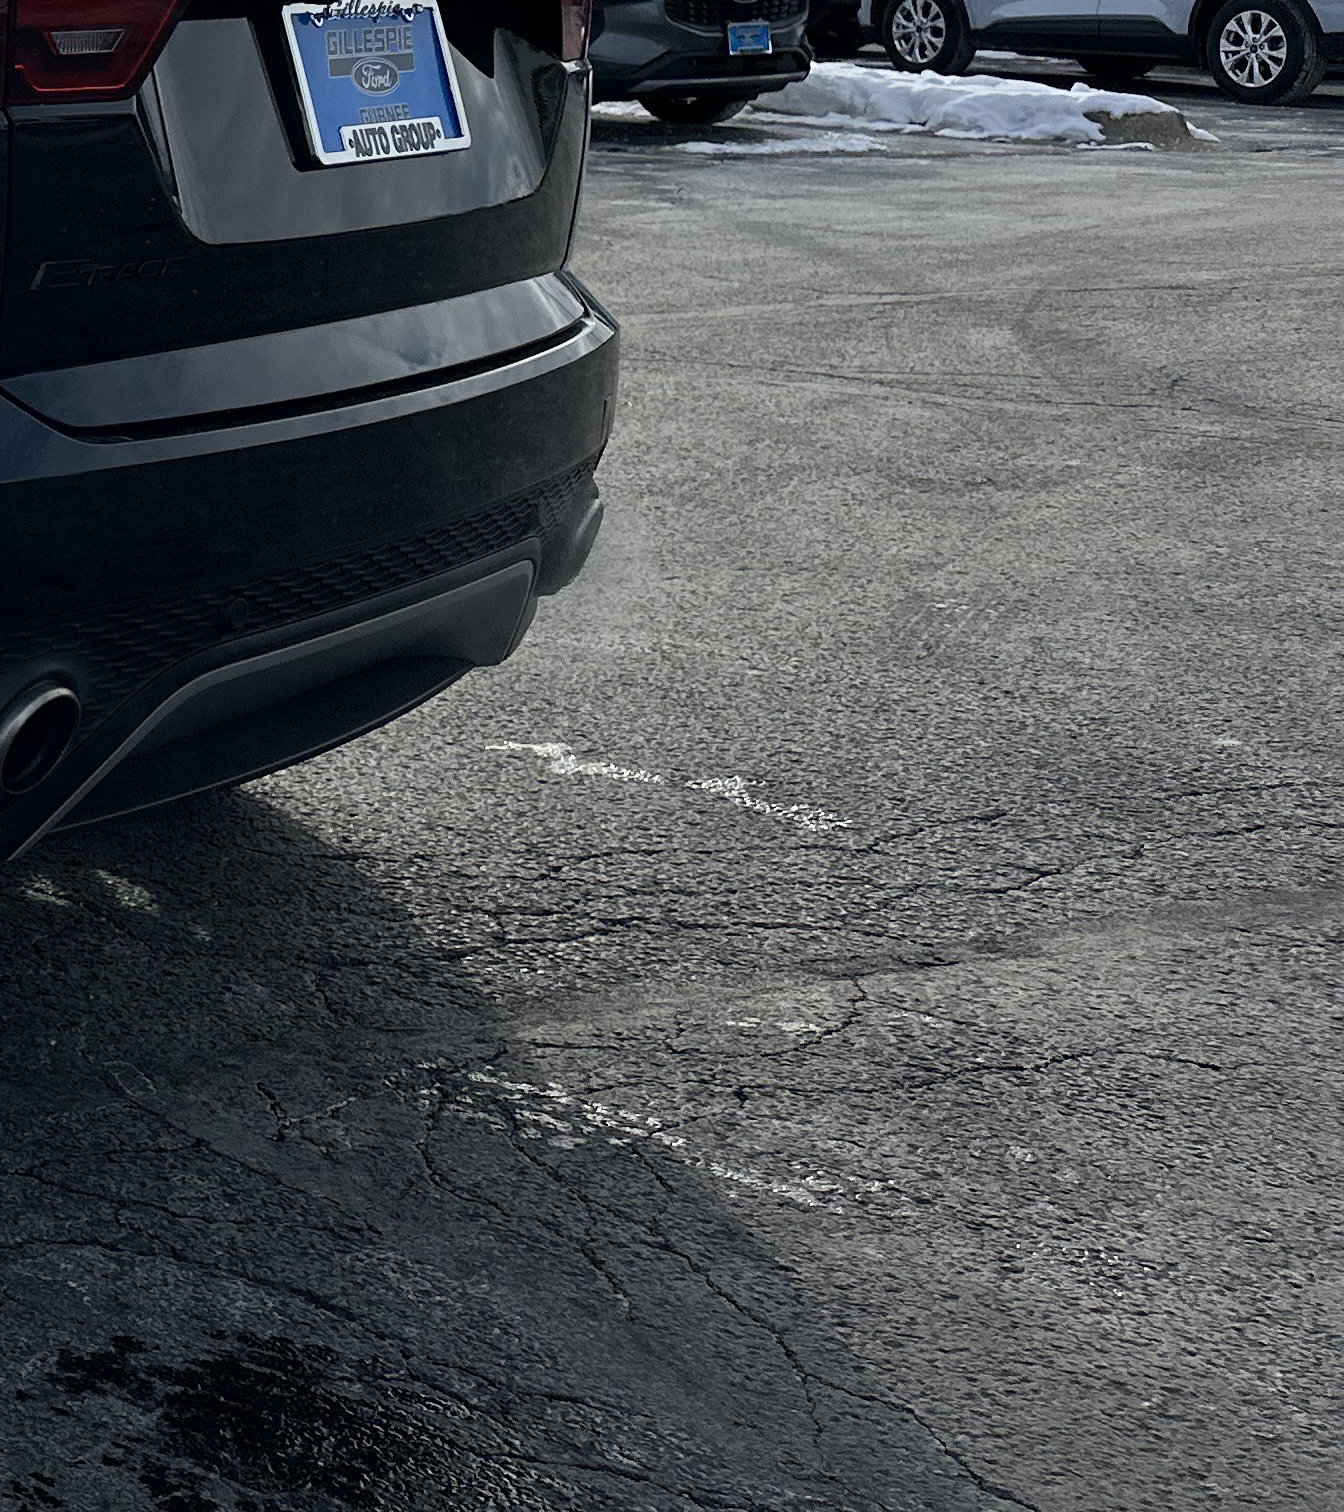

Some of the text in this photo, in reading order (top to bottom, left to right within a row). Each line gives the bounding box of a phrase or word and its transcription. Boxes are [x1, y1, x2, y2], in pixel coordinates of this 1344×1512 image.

[326, 25, 414, 56] GILLESPIE
[361, 63, 392, 89] Ford
[351, 121, 436, 158] AUTO GROUP
